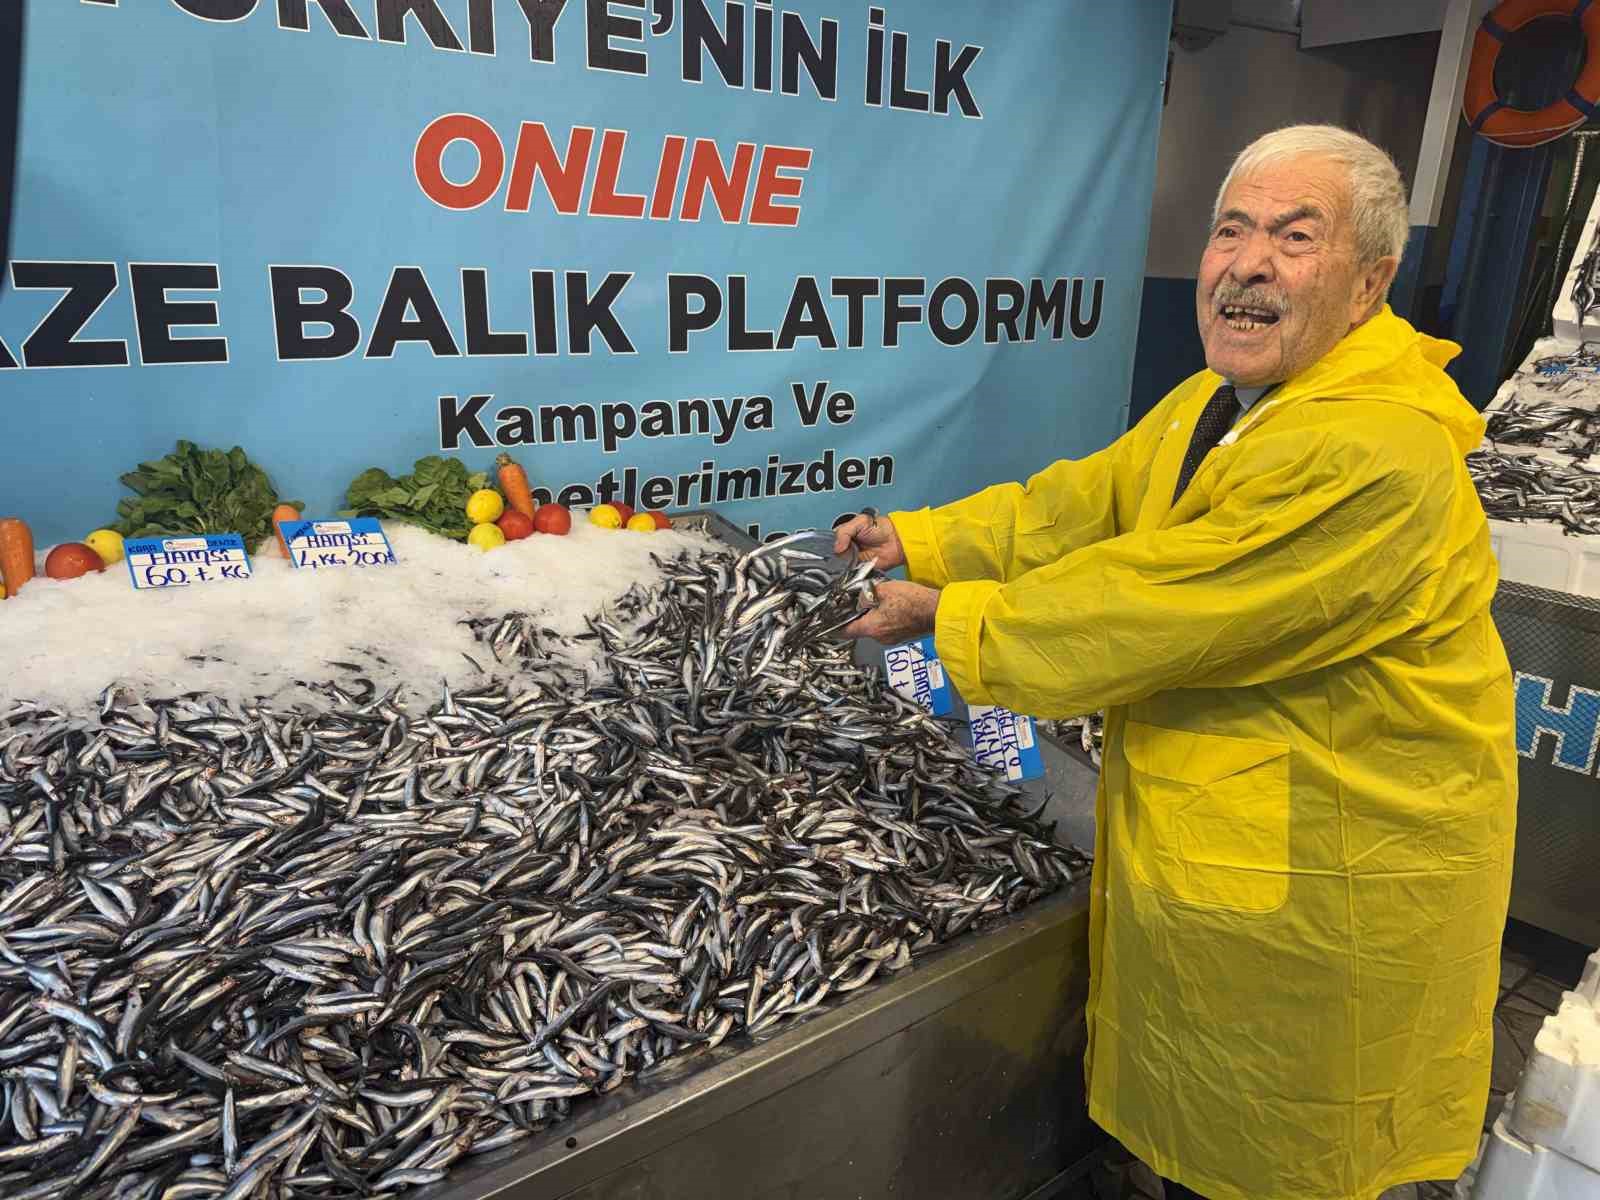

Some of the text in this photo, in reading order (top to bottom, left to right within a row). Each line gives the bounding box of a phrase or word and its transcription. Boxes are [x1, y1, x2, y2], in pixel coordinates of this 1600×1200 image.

[865, 6, 983, 119] İLK
[413, 113, 813, 227] ONLINE
[0, 260, 1104, 369] ZE BALIK PLATFORMU
[437, 381, 856, 452] Kampanya Ve
